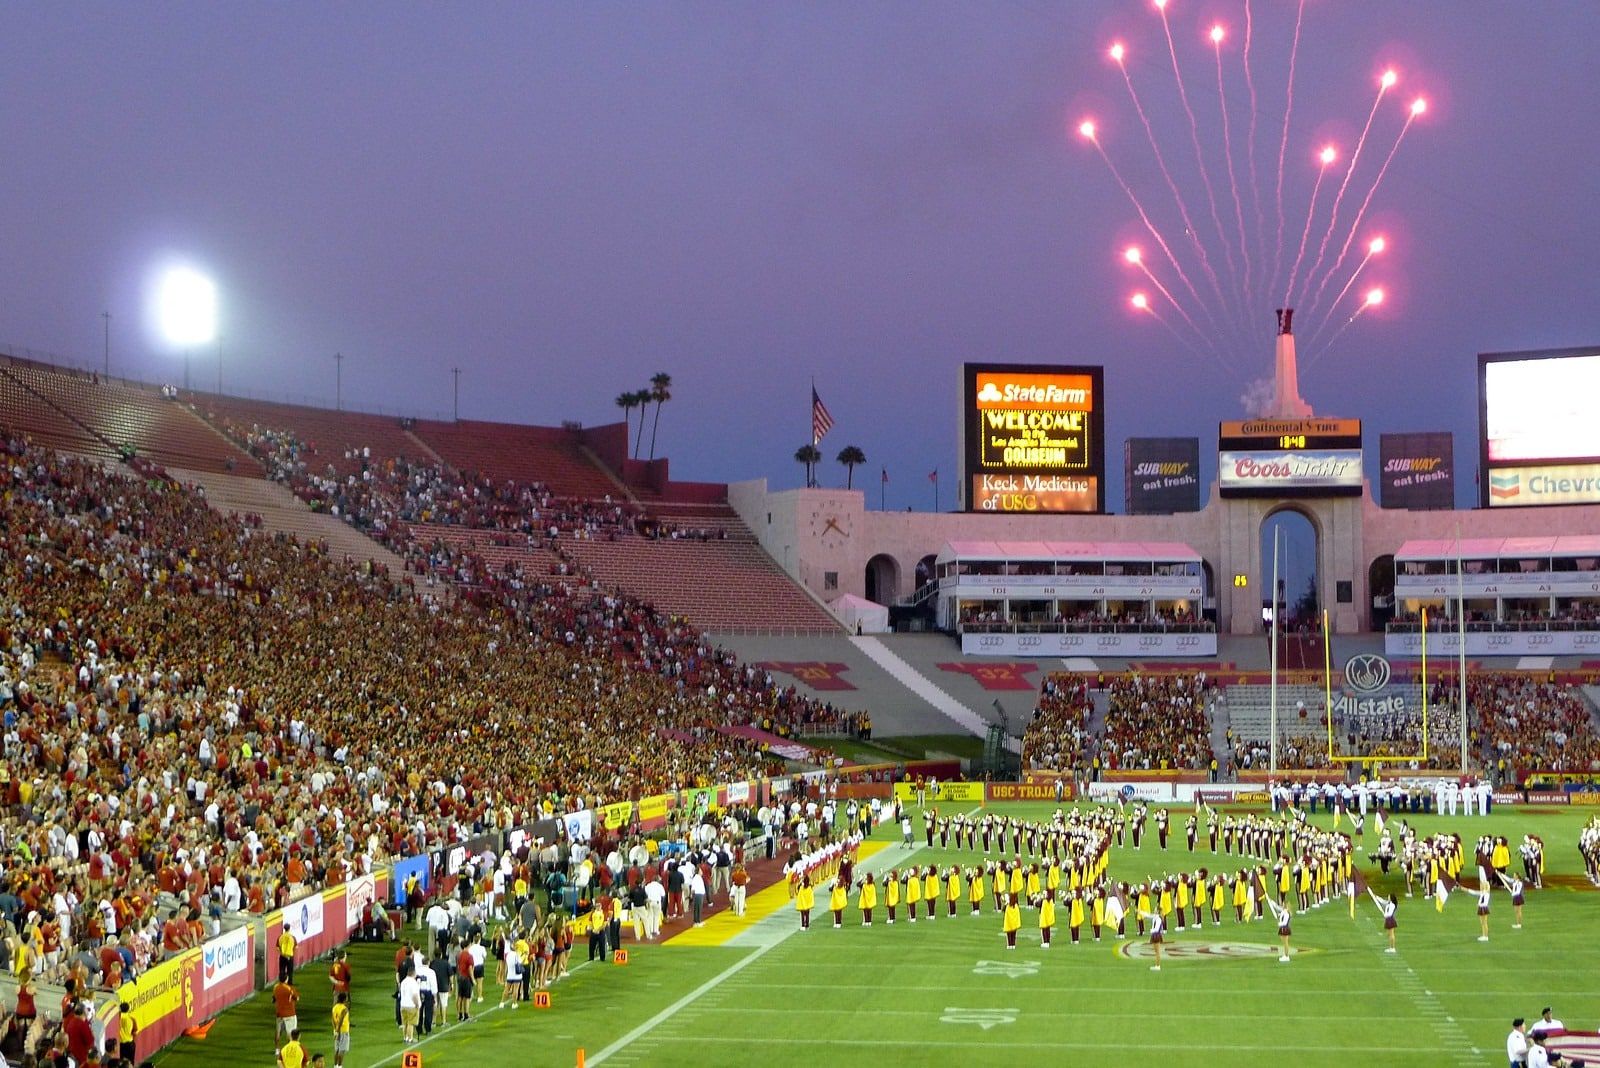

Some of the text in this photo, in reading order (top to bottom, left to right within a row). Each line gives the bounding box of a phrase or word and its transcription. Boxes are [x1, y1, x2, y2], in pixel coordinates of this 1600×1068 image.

[986, 410, 1082, 431] WELCOME
[1241, 422, 1303, 434] Continental
[1134, 463, 1186, 475] SUBWAY
[1234, 458, 1291, 478] Coors
[1384, 458, 1437, 472] SUBWAY
[983, 474, 1088, 492] Keck Medicine
[1143, 479, 1161, 491] eat
[1393, 475, 1412, 487] eat
[982, 493, 1037, 511] of USC
[976, 667, 1015, 680] 32
[1334, 695, 1405, 716] Allstate
[992, 786, 1071, 798] USC TROJAS
[217, 940, 246, 969] Chevron
[615, 952, 626, 961] 20
[535, 994, 548, 1006] 10
[404, 1054, 418, 1068] G
